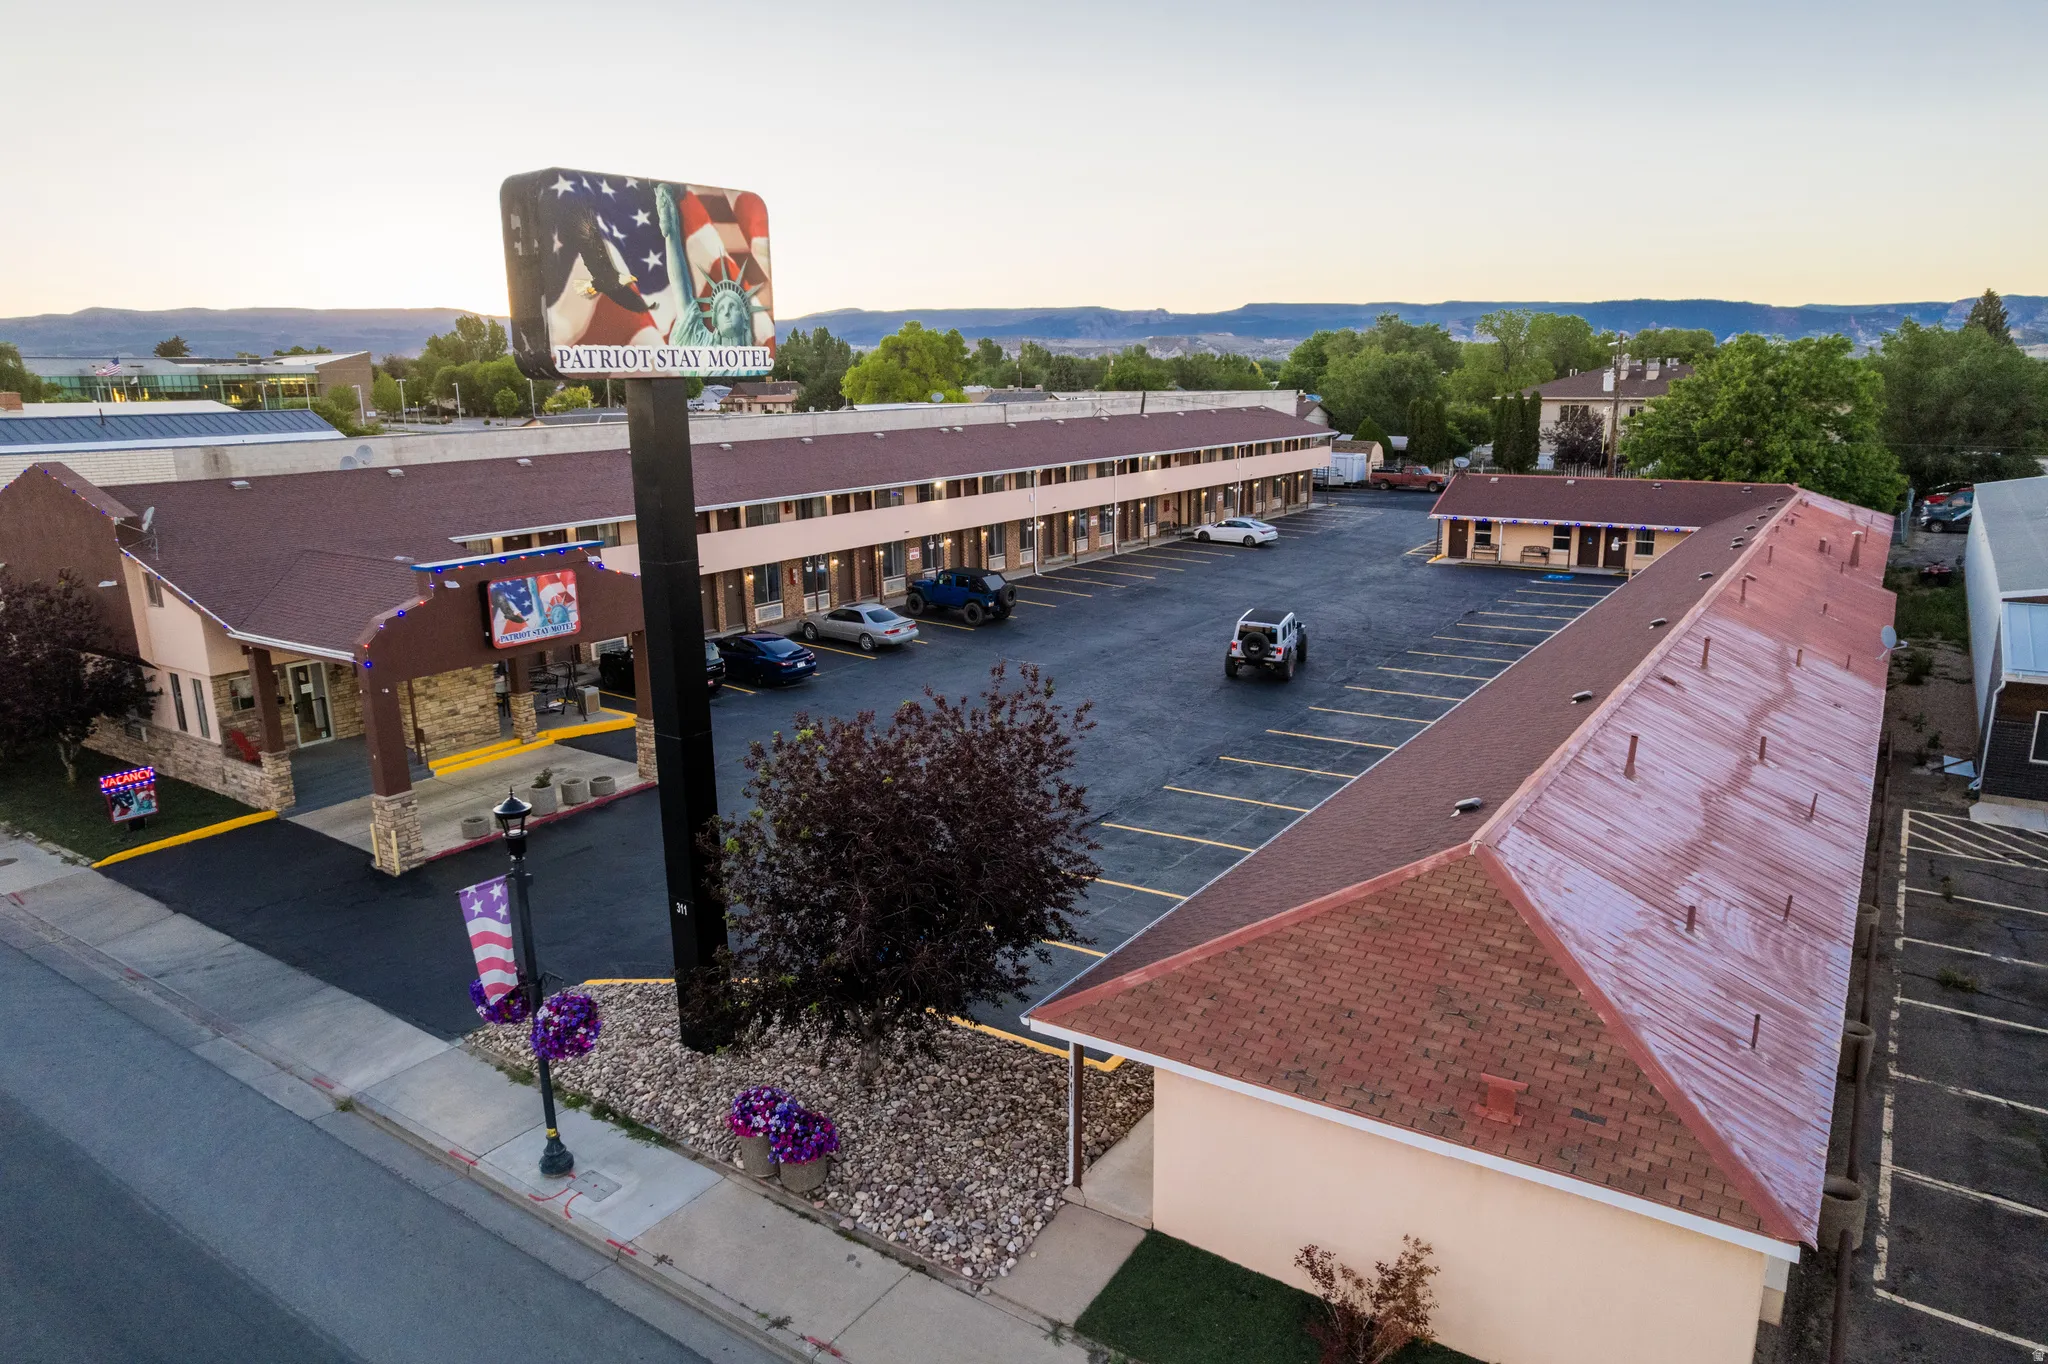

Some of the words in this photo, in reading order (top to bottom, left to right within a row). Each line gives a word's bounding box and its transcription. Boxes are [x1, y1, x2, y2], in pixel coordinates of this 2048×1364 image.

[558, 349, 651, 370] PATRIOT
[656, 349, 702, 368] STAY
[708, 349, 772, 368] MOTEL
[500, 630, 531, 643] PATRIOT
[532, 626, 550, 637] STAY
[551, 622, 575, 633] MOTEL
[102, 769, 151, 788] VACANCY
[676, 902, 688, 916] 311
